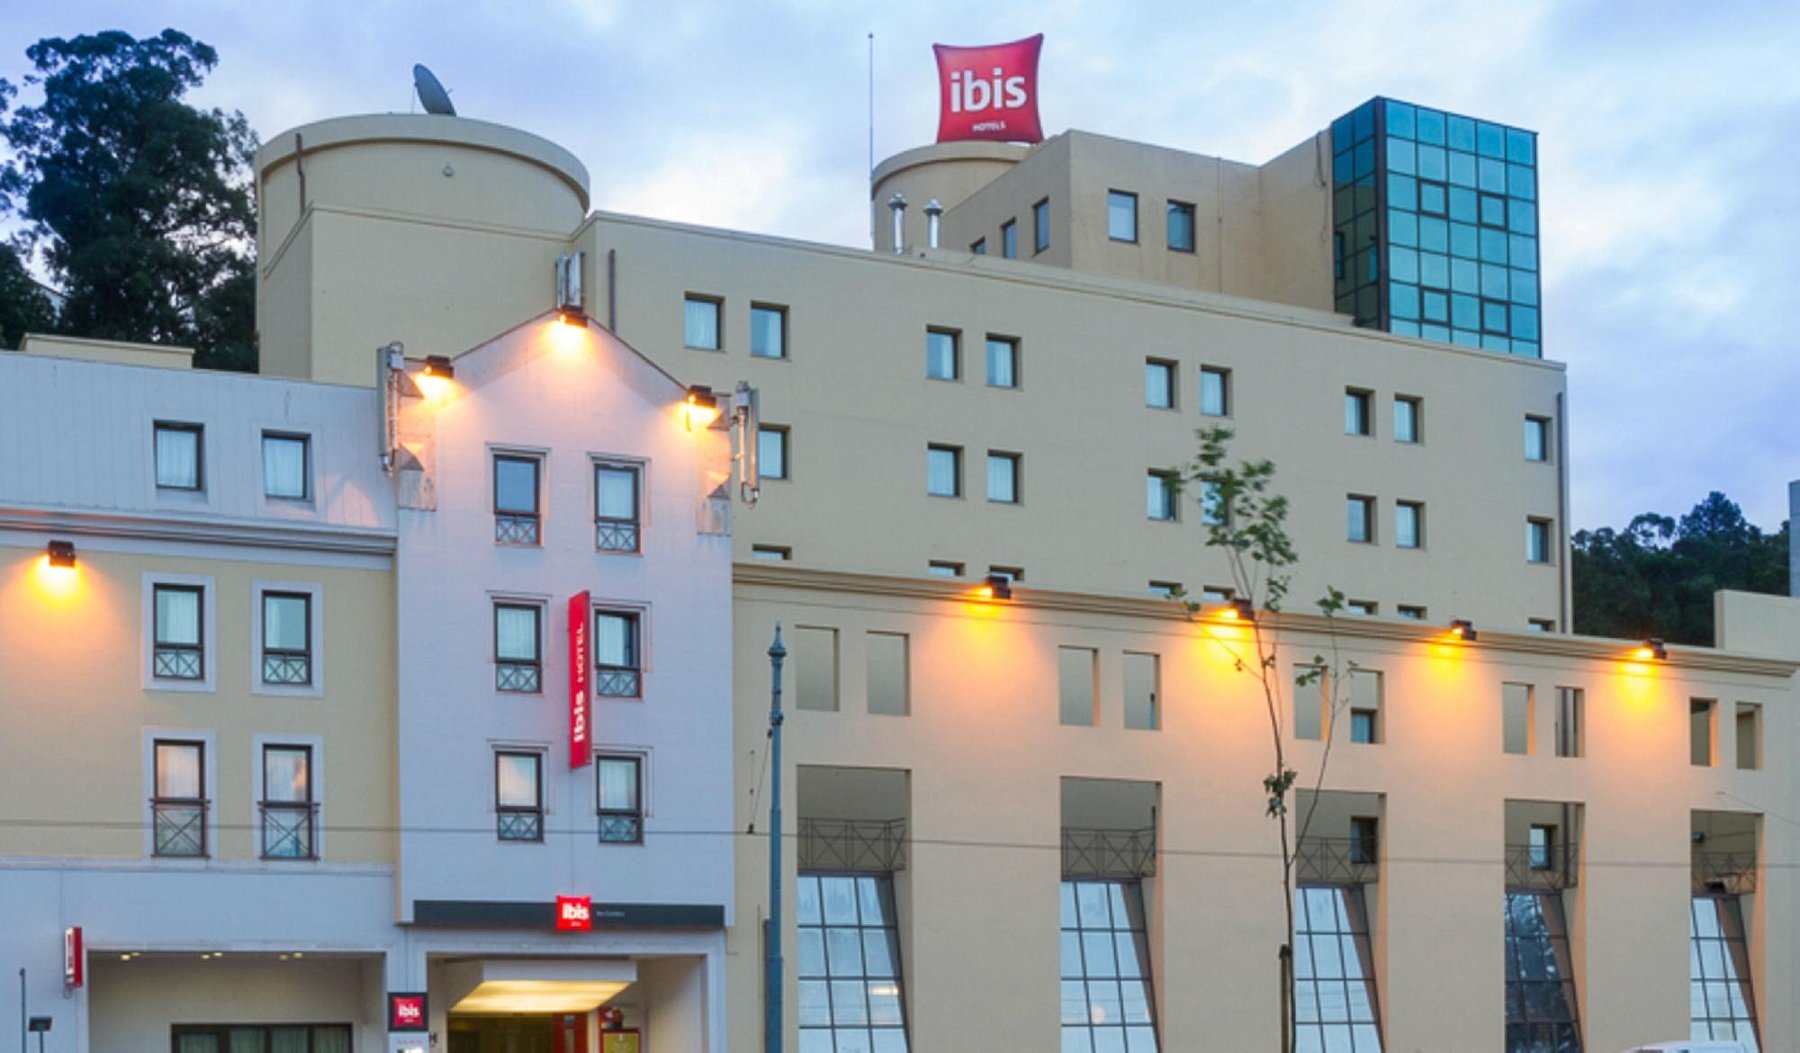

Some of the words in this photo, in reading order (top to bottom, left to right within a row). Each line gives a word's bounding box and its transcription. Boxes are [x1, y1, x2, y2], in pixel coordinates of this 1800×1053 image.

[950, 67, 1027, 113] ibis
[575, 622, 584, 683] HOTEL
[573, 690, 585, 743] ibis
[562, 902, 589, 920] ibis
[398, 1003, 420, 1018] ibis
